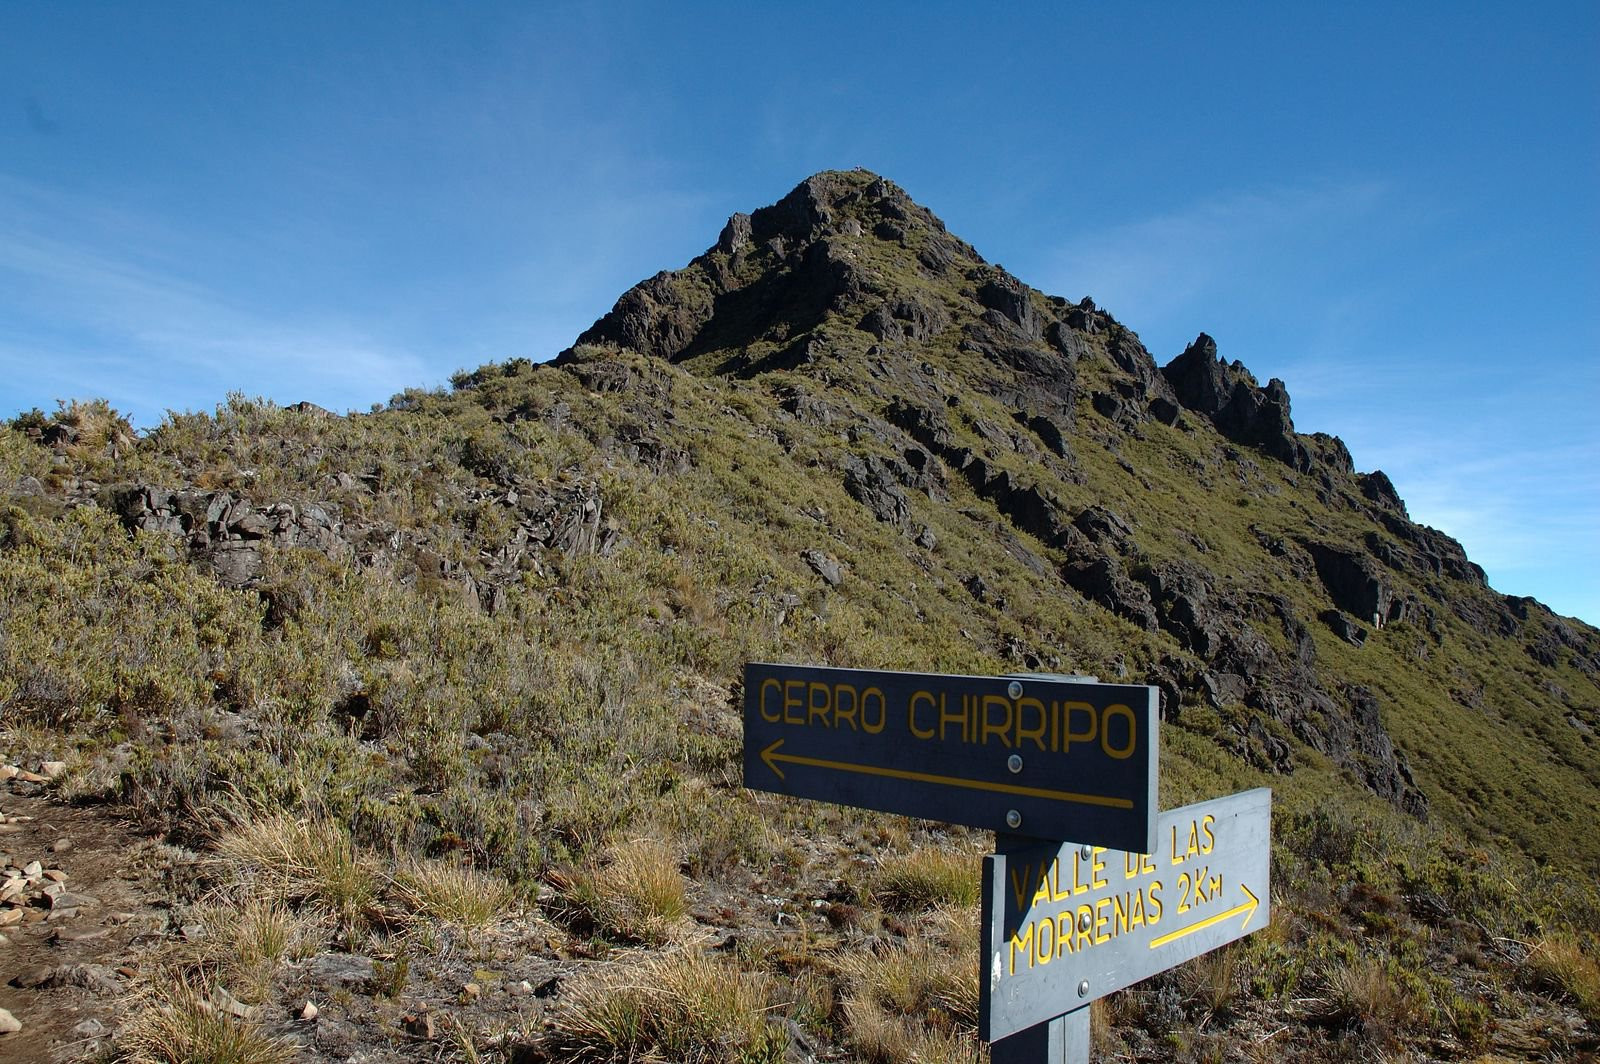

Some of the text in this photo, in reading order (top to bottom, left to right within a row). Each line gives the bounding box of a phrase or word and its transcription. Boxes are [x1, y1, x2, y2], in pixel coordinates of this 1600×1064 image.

[760, 678, 1136, 759] CERRO CHIRRIPO
[1011, 846, 1108, 912] VALLE
[1171, 815, 1215, 866] LAS
[1010, 881, 1163, 976] MORRENAS
